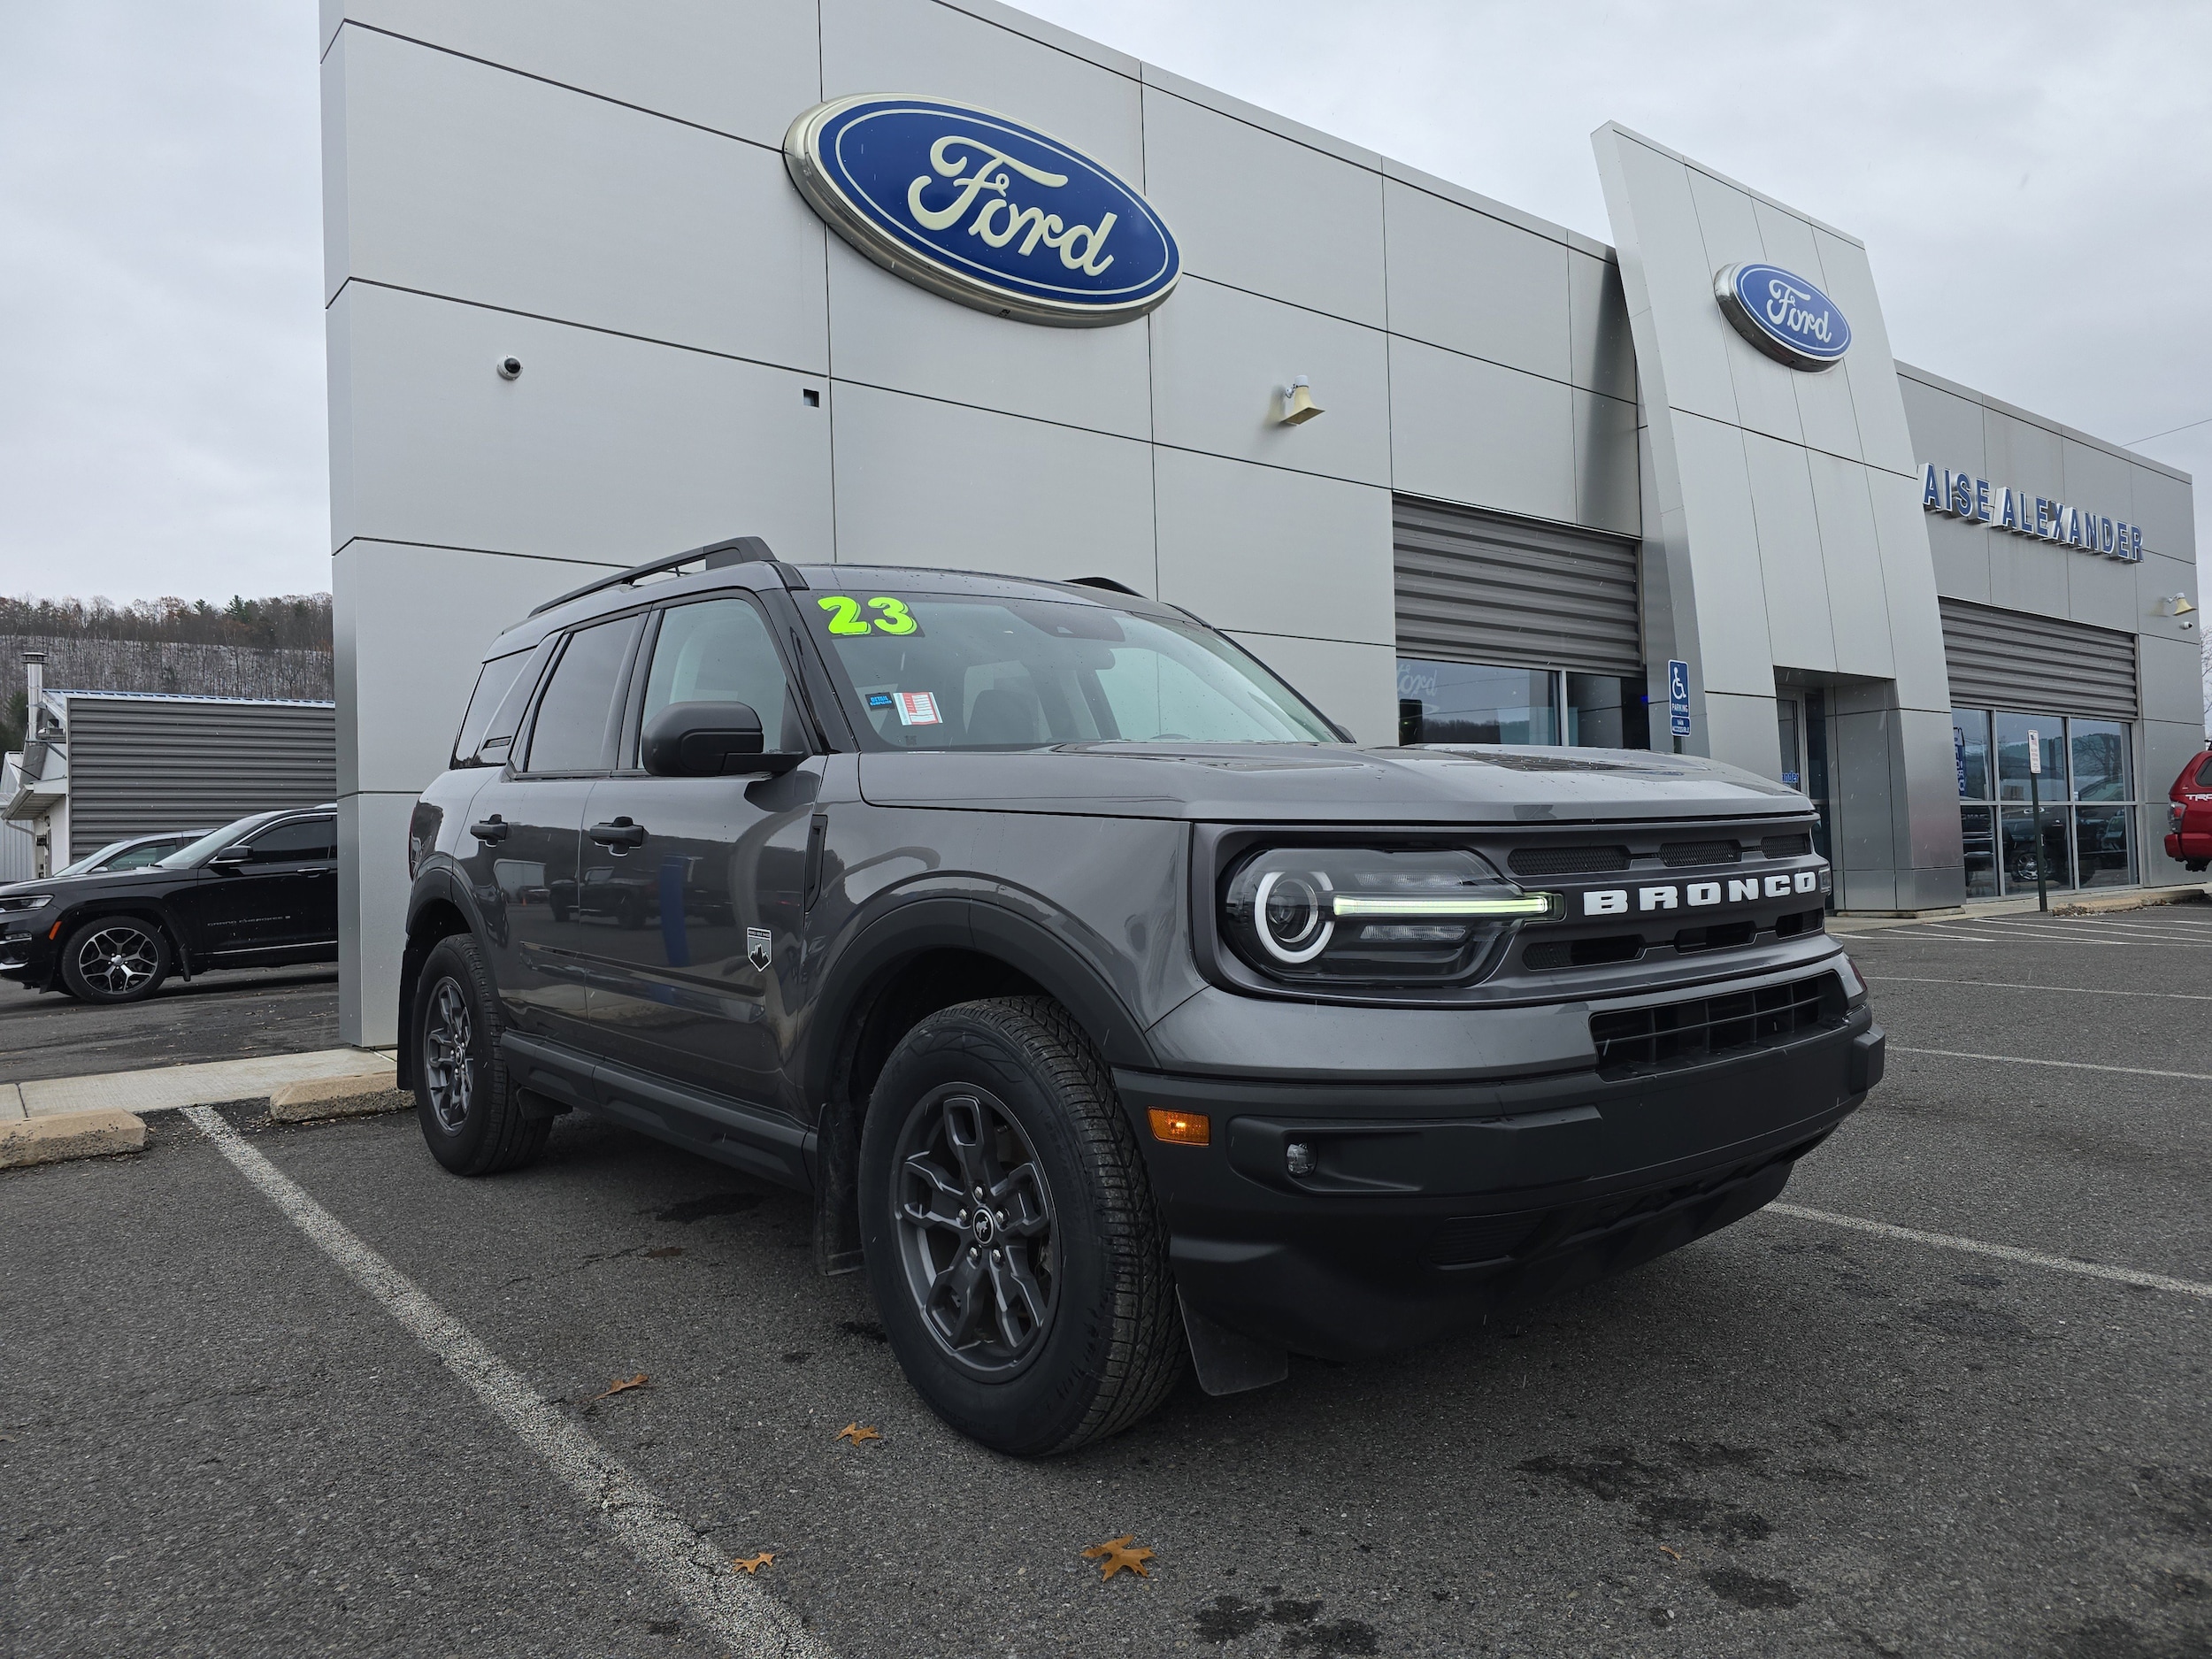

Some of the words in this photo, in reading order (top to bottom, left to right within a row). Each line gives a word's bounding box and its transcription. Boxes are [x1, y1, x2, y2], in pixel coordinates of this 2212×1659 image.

[908, 134, 1118, 277] Ford
[1766, 278, 1832, 343] Ford
[1921, 462, 1991, 522] AISE
[1993, 486, 2144, 563] ALEXANDER
[817, 595, 918, 635] 23
[1672, 703, 1688, 712] PARKING
[1583, 871, 1817, 916] BRONCO
